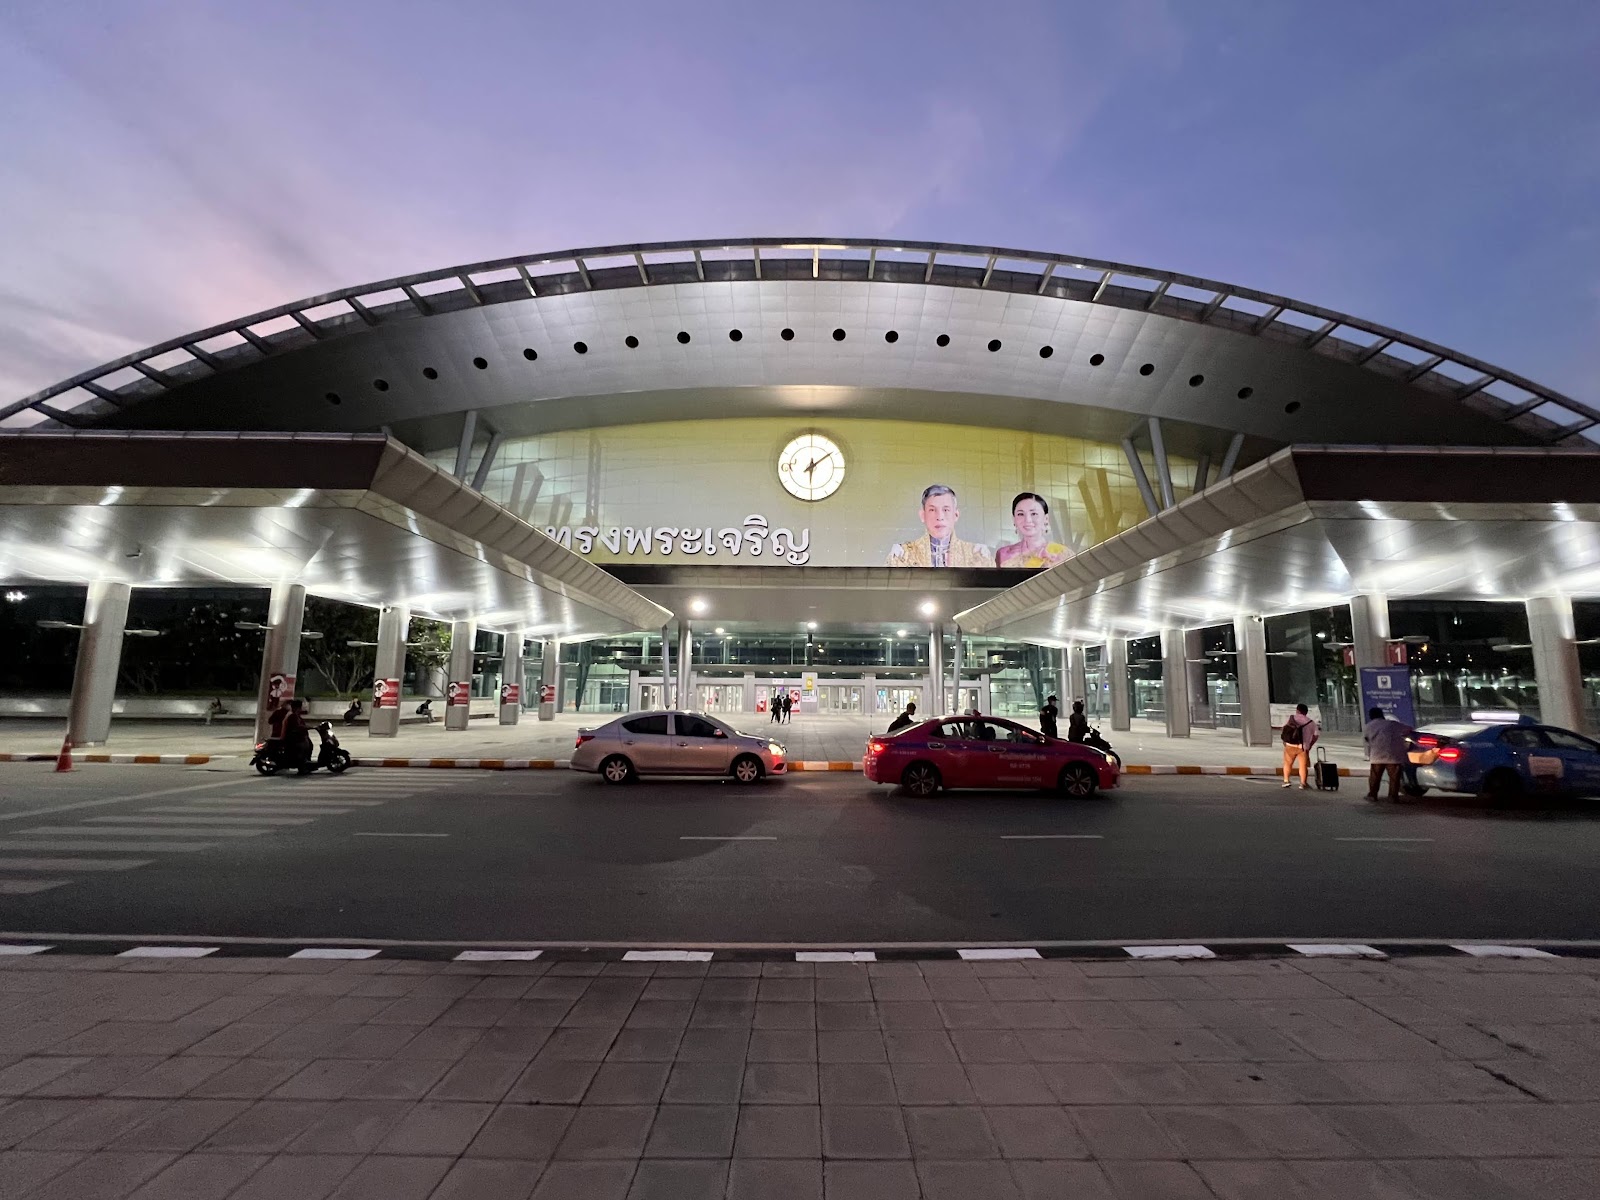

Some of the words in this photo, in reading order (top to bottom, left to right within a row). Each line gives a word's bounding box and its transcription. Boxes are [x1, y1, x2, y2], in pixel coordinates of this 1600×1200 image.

[544, 514, 810, 565] ทรงพระเจริญ
[1348, 650, 1355, 666] 1
[1395, 647, 1402, 663] 1
